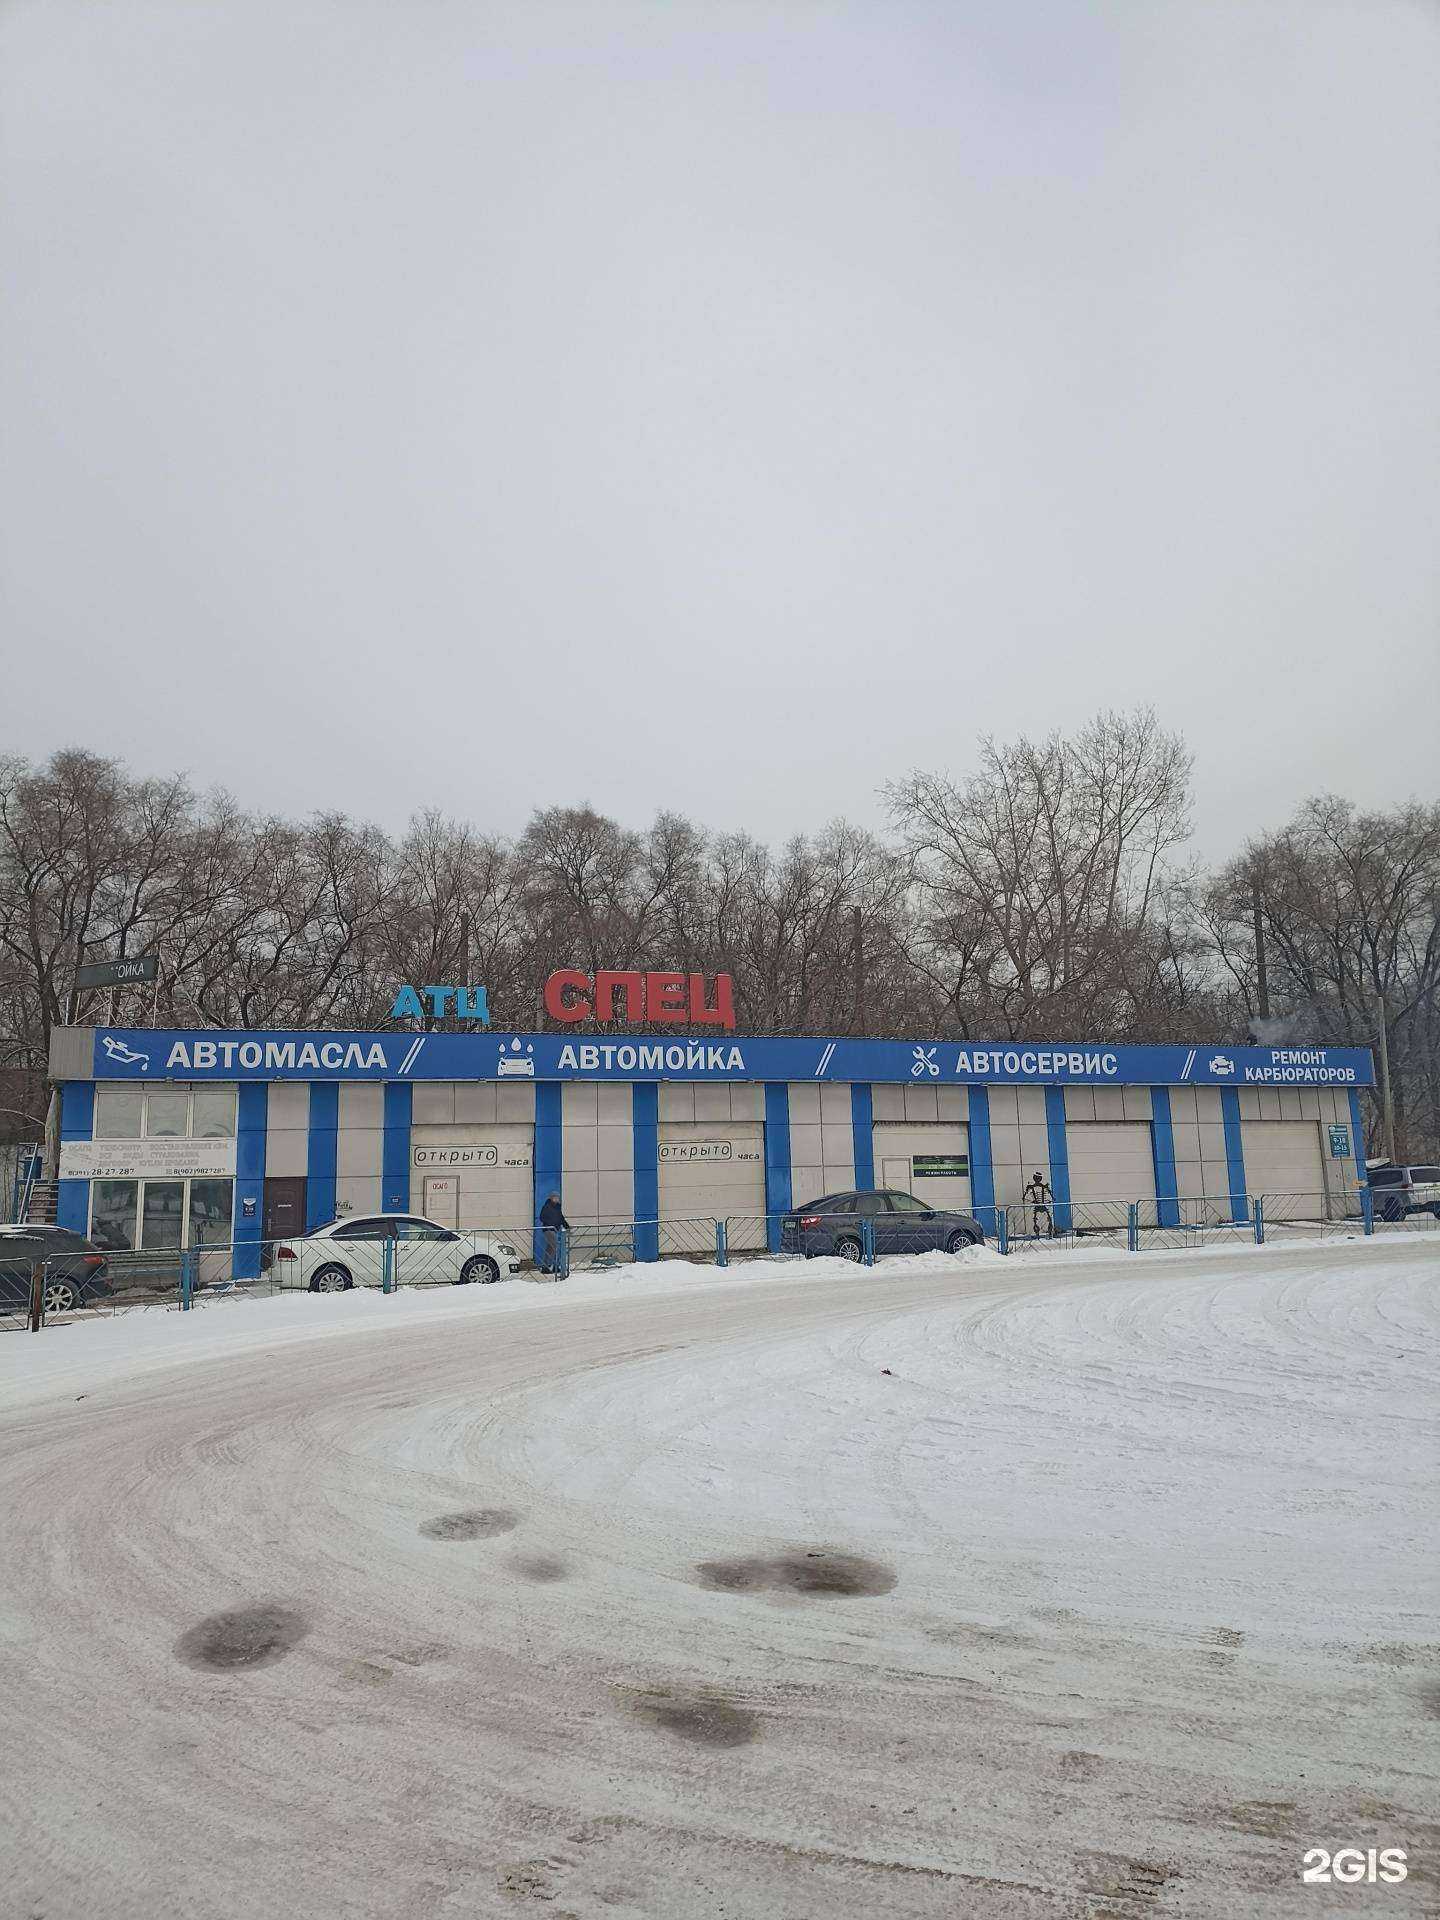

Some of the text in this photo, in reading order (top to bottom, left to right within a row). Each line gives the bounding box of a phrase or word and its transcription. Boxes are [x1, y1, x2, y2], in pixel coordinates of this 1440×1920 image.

[111, 960, 144, 978] ОЙКА
[391, 969, 736, 1030] АТЦ СПЕЦ
[166, 1041, 388, 1069] АВТОМАСЛА
[558, 1040, 745, 1070] АВТОМОЙКА
[955, 1051, 1118, 1075] АВТОСЕРВИС
[1271, 1051, 1327, 1065] РЕМОНТ
[1245, 1067, 1356, 1082] КАРБЮРАТОРОВ
[91, 1168, 135, 1176] 28-27-287
